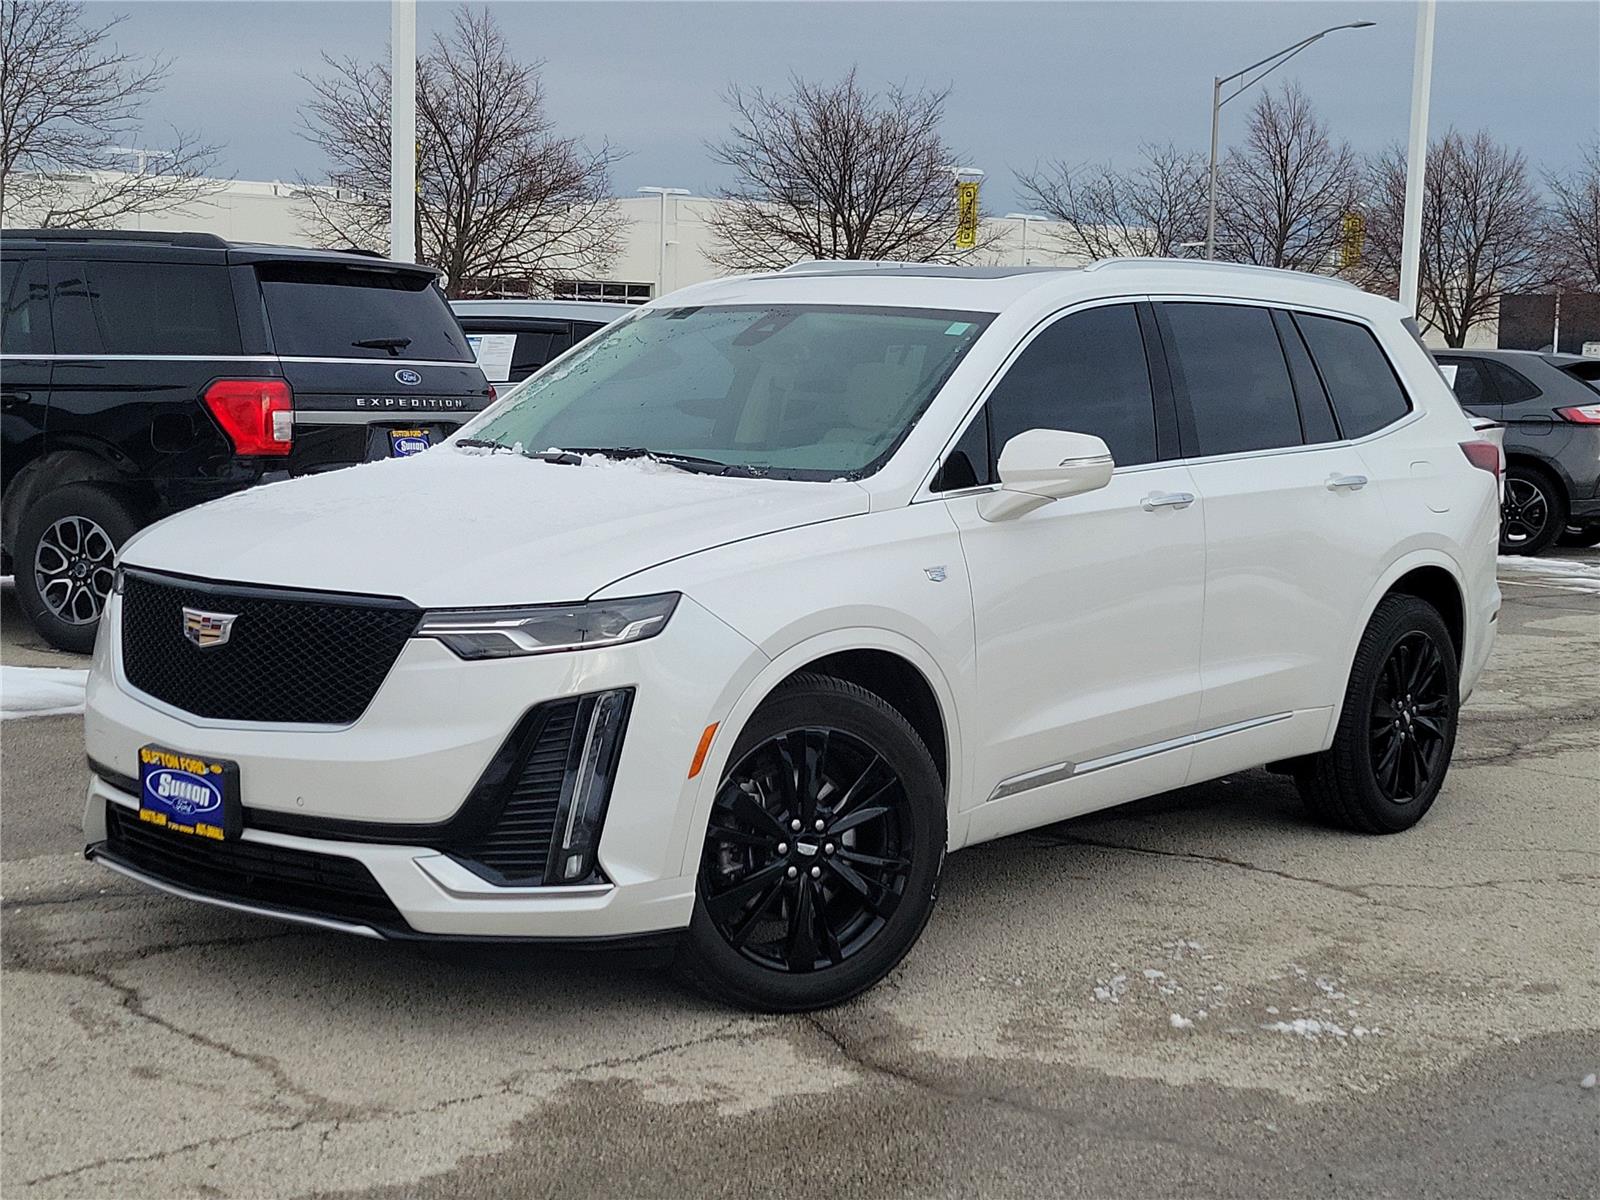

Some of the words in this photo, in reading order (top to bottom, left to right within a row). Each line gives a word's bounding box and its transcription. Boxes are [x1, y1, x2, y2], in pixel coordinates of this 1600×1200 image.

[356, 398, 462, 408] EXPEDITION
[401, 440, 425, 452] Sutton
[158, 773, 210, 807] Sutton
